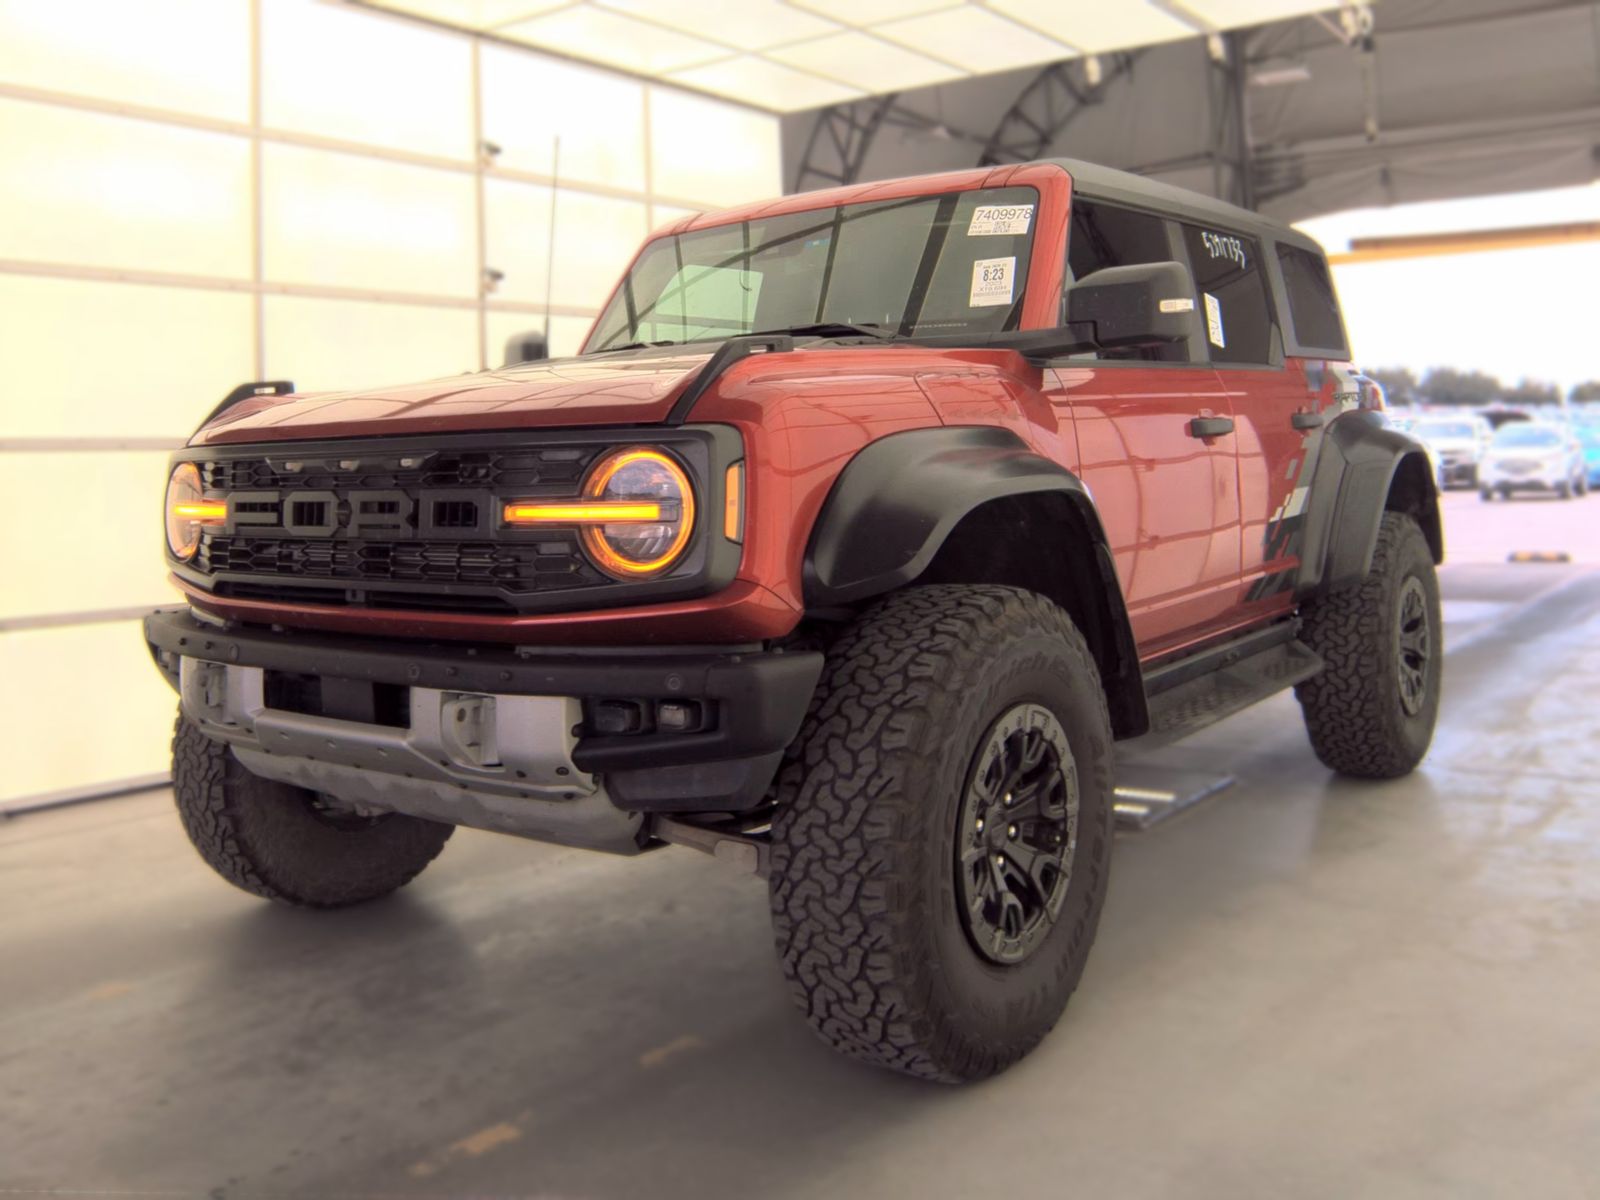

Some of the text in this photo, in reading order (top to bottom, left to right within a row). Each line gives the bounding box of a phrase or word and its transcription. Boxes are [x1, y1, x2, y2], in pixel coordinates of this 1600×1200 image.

[976, 208, 1033, 221] 7409978
[983, 267, 1004, 282] 8:23
[226, 490, 499, 539] FORD
